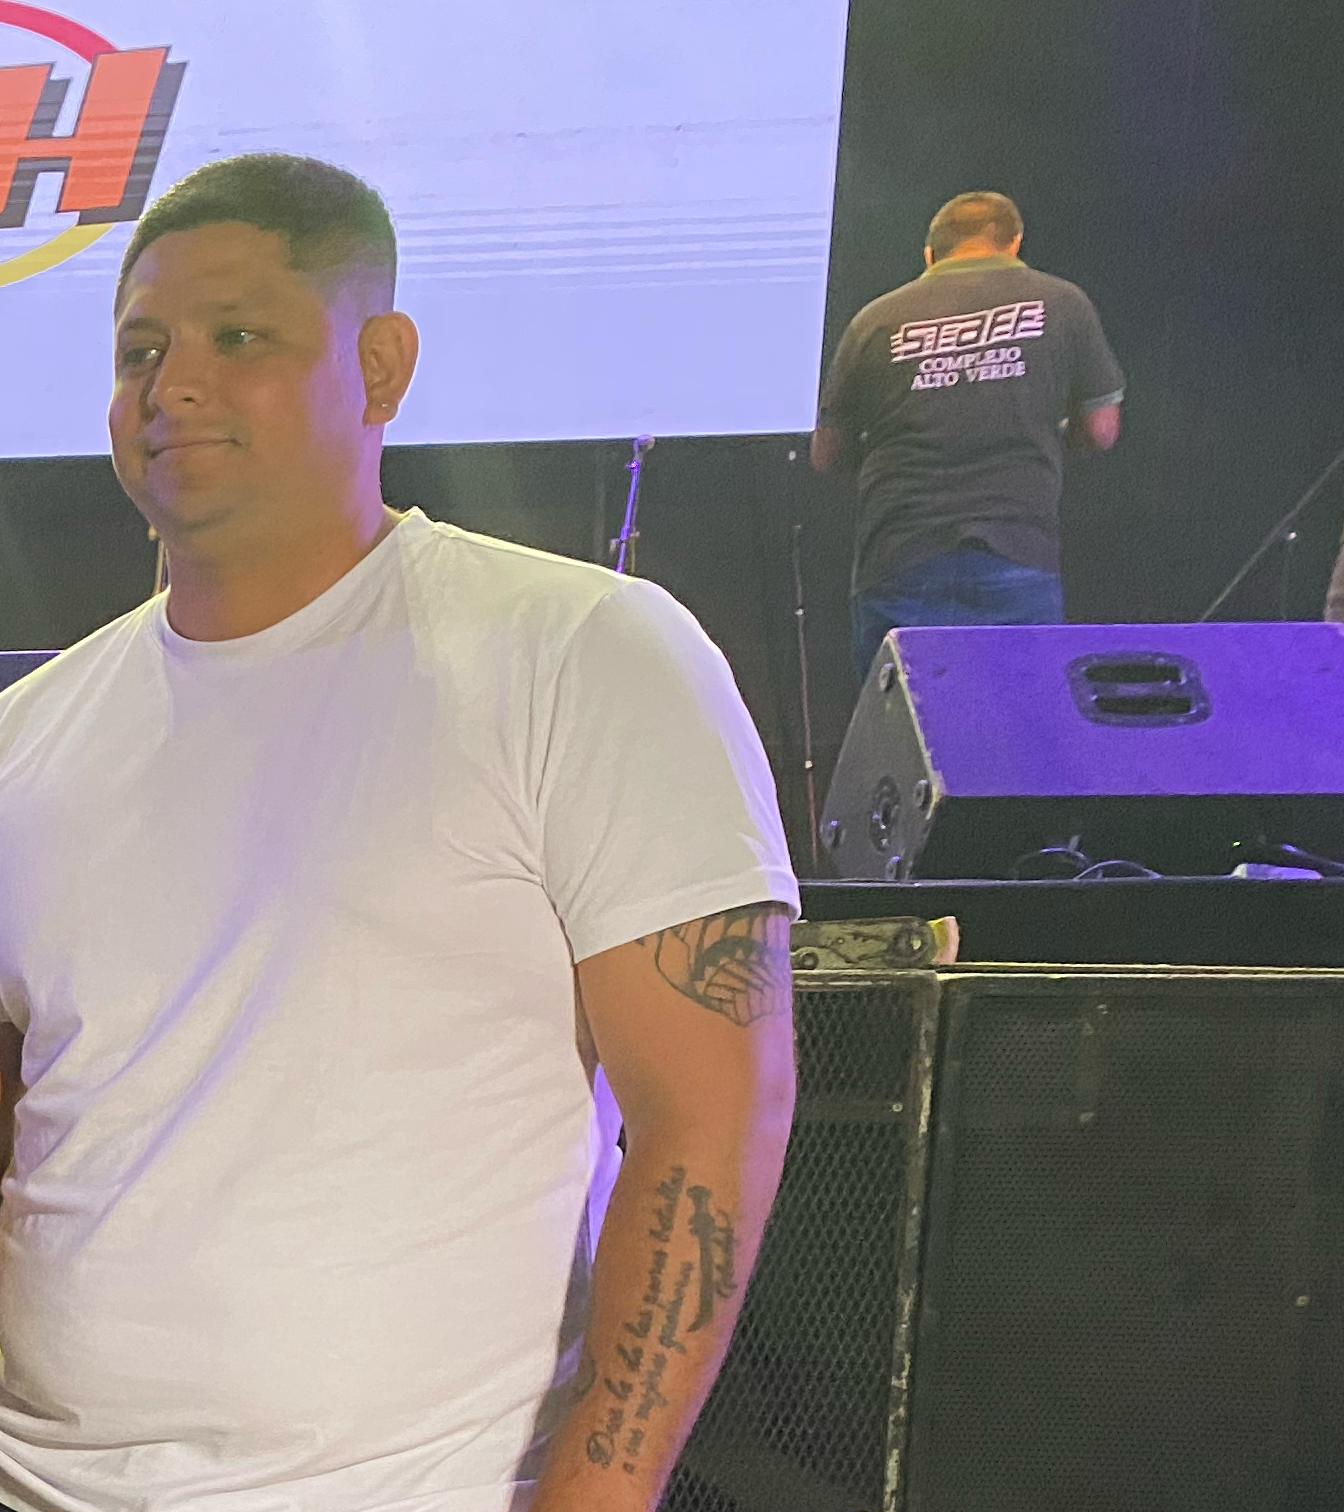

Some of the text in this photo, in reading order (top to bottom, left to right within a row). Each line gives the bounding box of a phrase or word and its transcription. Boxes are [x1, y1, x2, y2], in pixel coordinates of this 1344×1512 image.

[918, 345, 1022, 374] COMPLEJO
[910, 360, 1026, 391] ALTO VERDE
